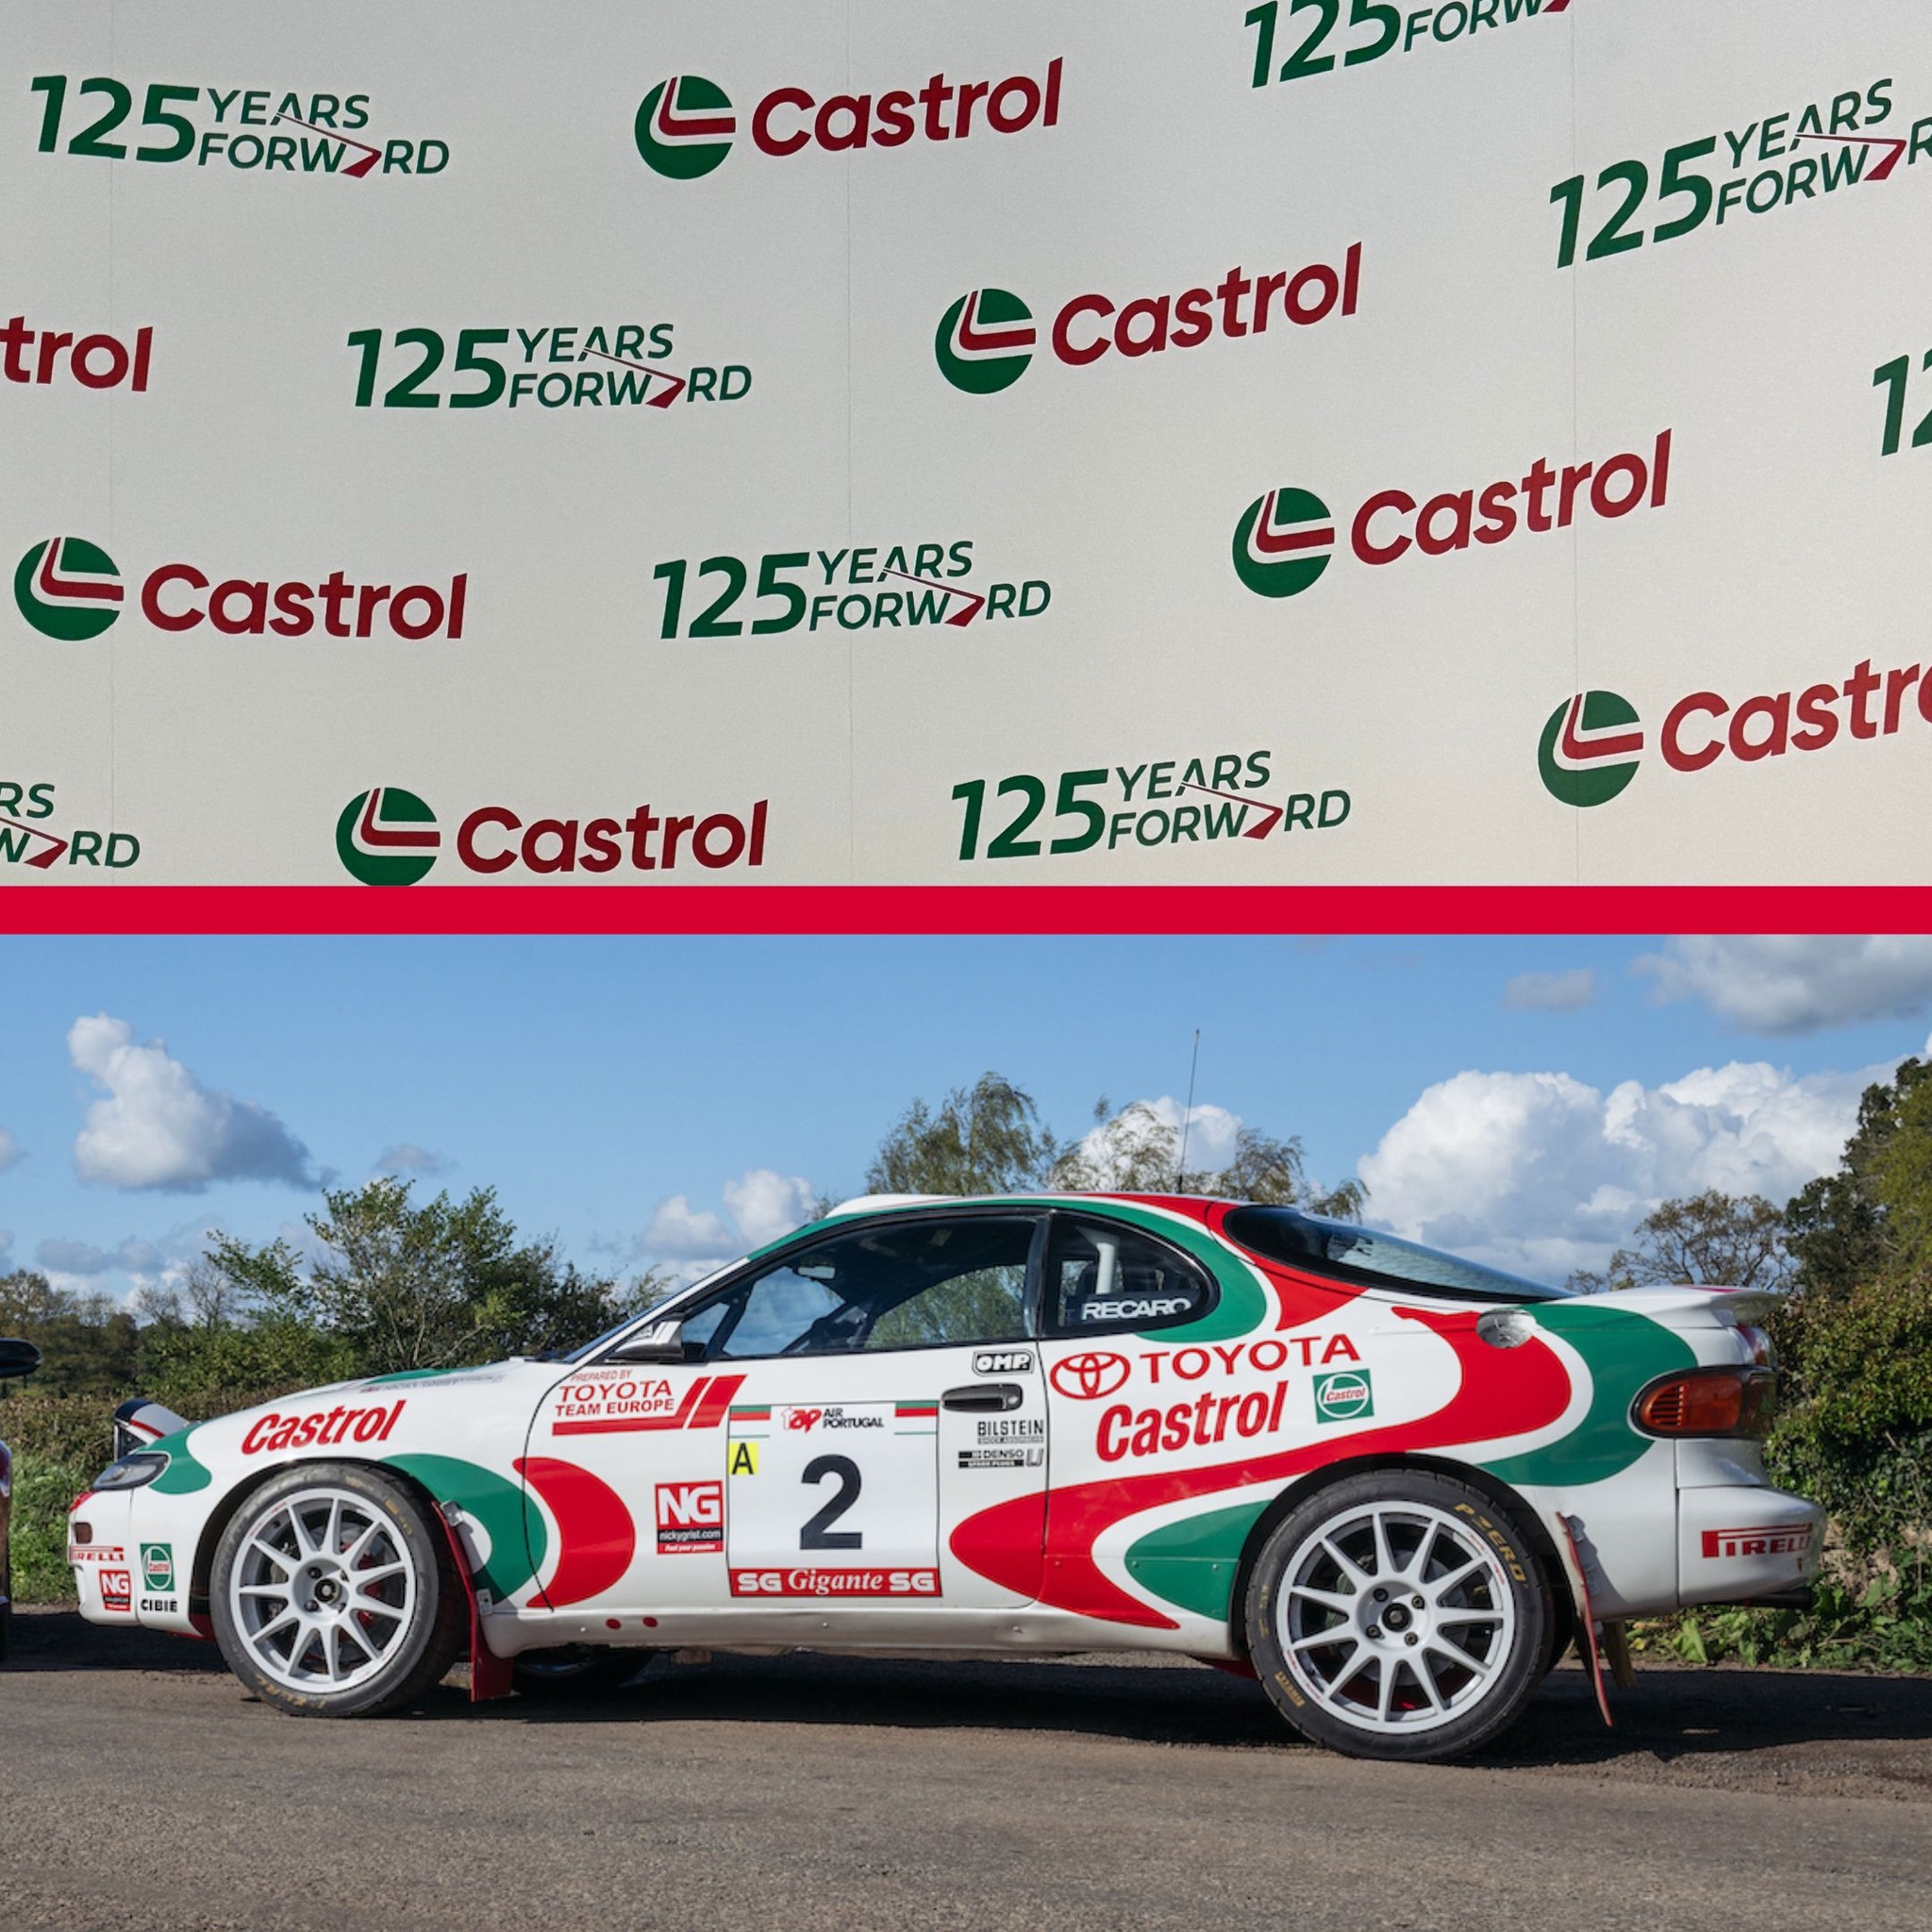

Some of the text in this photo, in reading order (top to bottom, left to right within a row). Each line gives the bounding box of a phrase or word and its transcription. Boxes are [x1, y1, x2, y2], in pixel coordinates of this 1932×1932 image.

[1243, 0, 1570, 91] 125 FORW
[29, 75, 370, 164] 125 YEARS
[752, 57, 1063, 157] Castrol
[1549, 78, 1892, 269] 125 YEARS
[1715, 118, 1932, 225] FORWAR
[1052, 242, 1361, 366] Castrol
[0, 315, 153, 392] trol
[346, 324, 674, 409] 125 YEARS
[1351, 428, 1672, 566] Castrol
[141, 563, 468, 641] Castrol
[652, 541, 973, 641] 125 YEARS
[1660, 658, 1932, 773] Castr
[457, 799, 768, 874] Castrol
[951, 751, 1270, 860] 125 YEARS
[1081, 1297, 1192, 1321] RECARO
[558, 1379, 673, 1404] TOYOTA
[571, 1369, 633, 1382] PREPARED BY
[1139, 1333, 1362, 1384] TOYOTA
[1326, 1386, 1367, 1403] Castrol
[241, 1398, 408, 1456] Castrol
[555, 1398, 675, 1417] TEAM EUROPE
[823, 1417, 885, 1429] PORTUGAL
[824, 1407, 843, 1418] AIR
[977, 1419, 1044, 1436] BILSTEIN
[1095, 1380, 1290, 1463] Castrol
[731, 1442, 755, 1475] A
[658, 1486, 721, 1525] NG
[799, 1454, 863, 1550] 2
[1454, 1503, 1475, 1515] P
[1471, 1515, 1526, 1581] ZERO
[1701, 1523, 1813, 1558] PIRELLI
[101, 1573, 130, 1595] NG
[737, 1568, 936, 1595] SG Gigante SG
